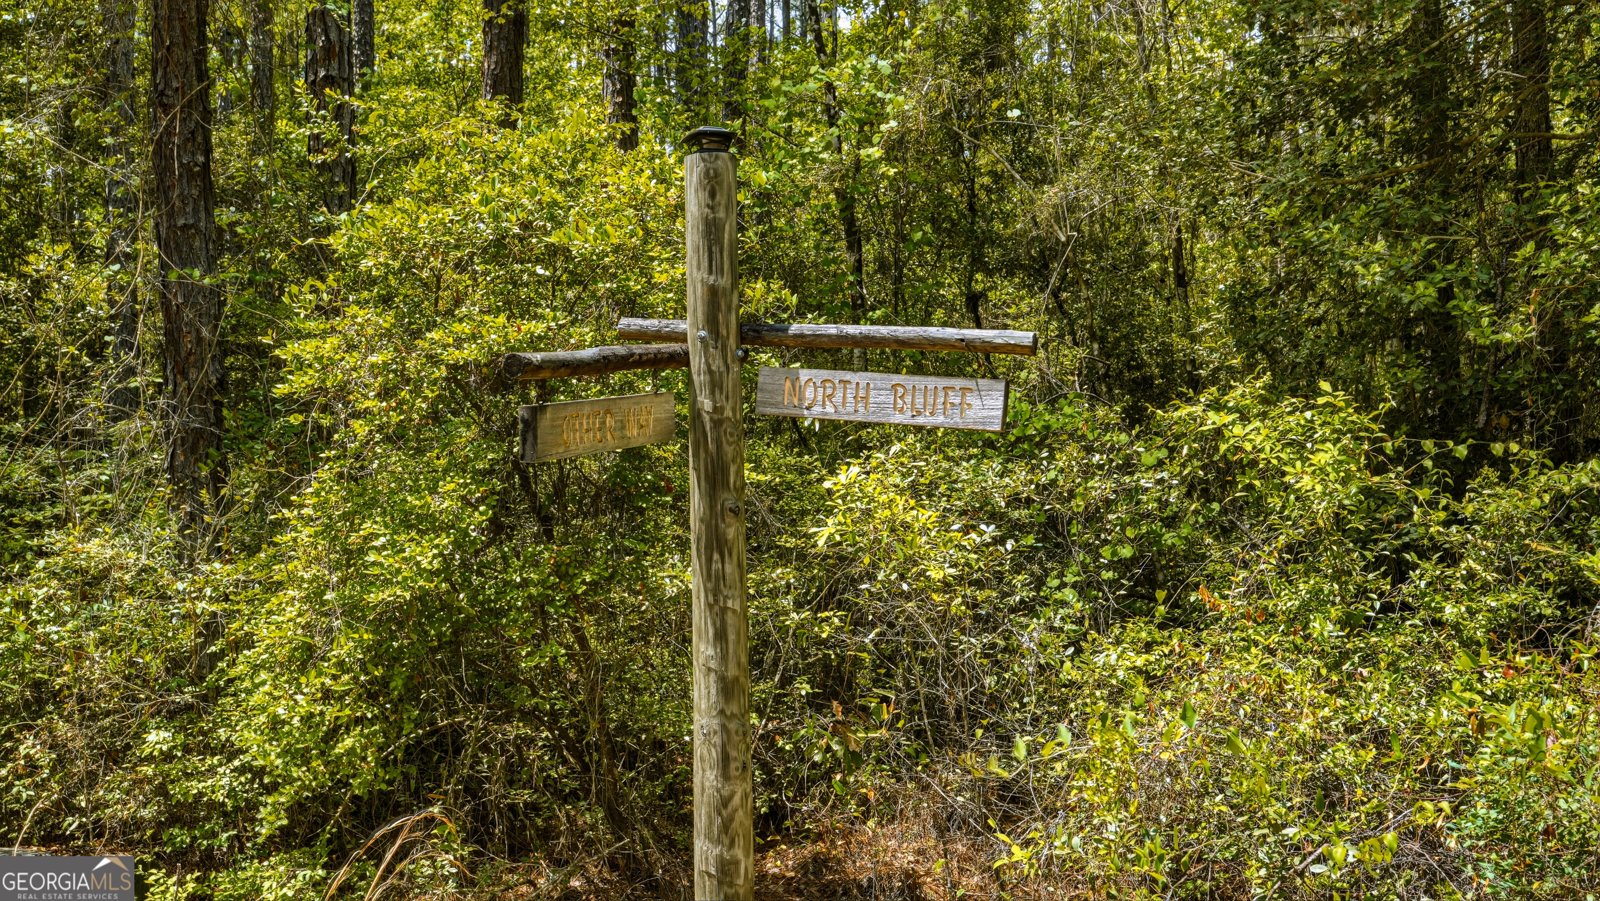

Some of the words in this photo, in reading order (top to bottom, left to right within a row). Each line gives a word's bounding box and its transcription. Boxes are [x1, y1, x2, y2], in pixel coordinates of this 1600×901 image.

[783, 376, 871, 413] NORTH
[891, 383, 973, 417] BLUFF
[562, 408, 615, 448] OTHER
[624, 405, 654, 439] WAY
